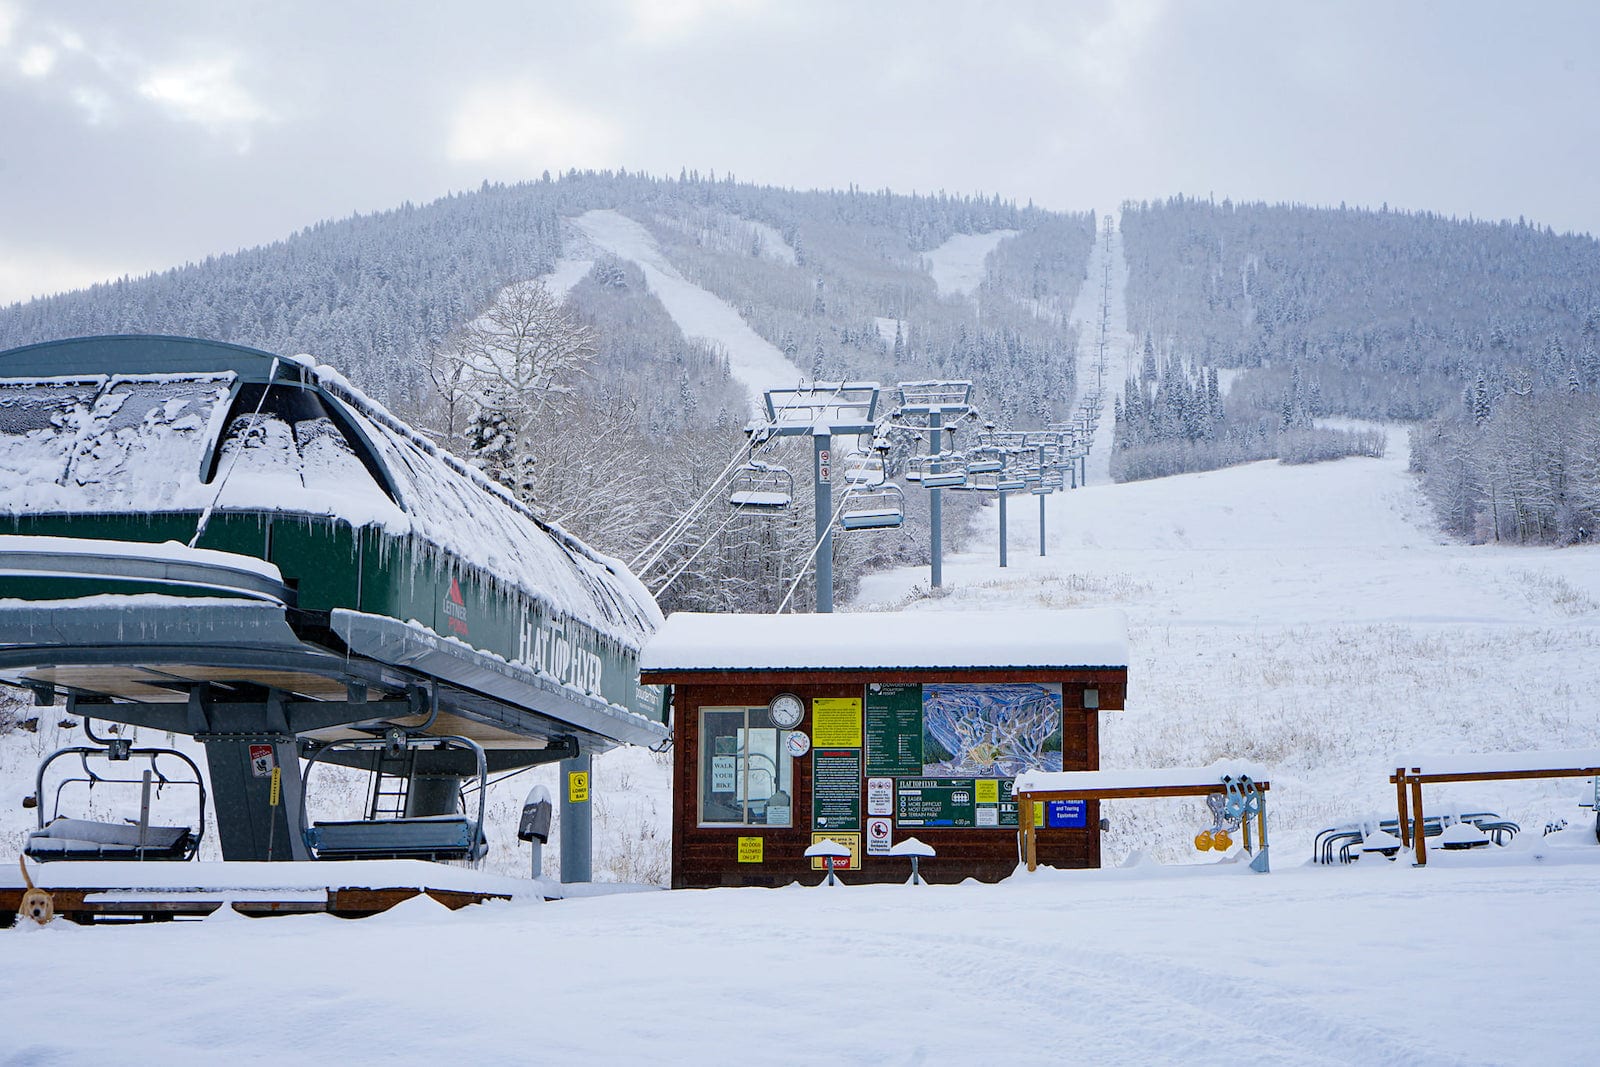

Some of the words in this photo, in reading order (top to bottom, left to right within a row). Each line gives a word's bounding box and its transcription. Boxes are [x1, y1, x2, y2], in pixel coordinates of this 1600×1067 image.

[443, 598, 467, 621] LEITNER
[519, 597, 550, 673] FLAT
[541, 617, 570, 682] TOP
[570, 619, 602, 696] FLYER
